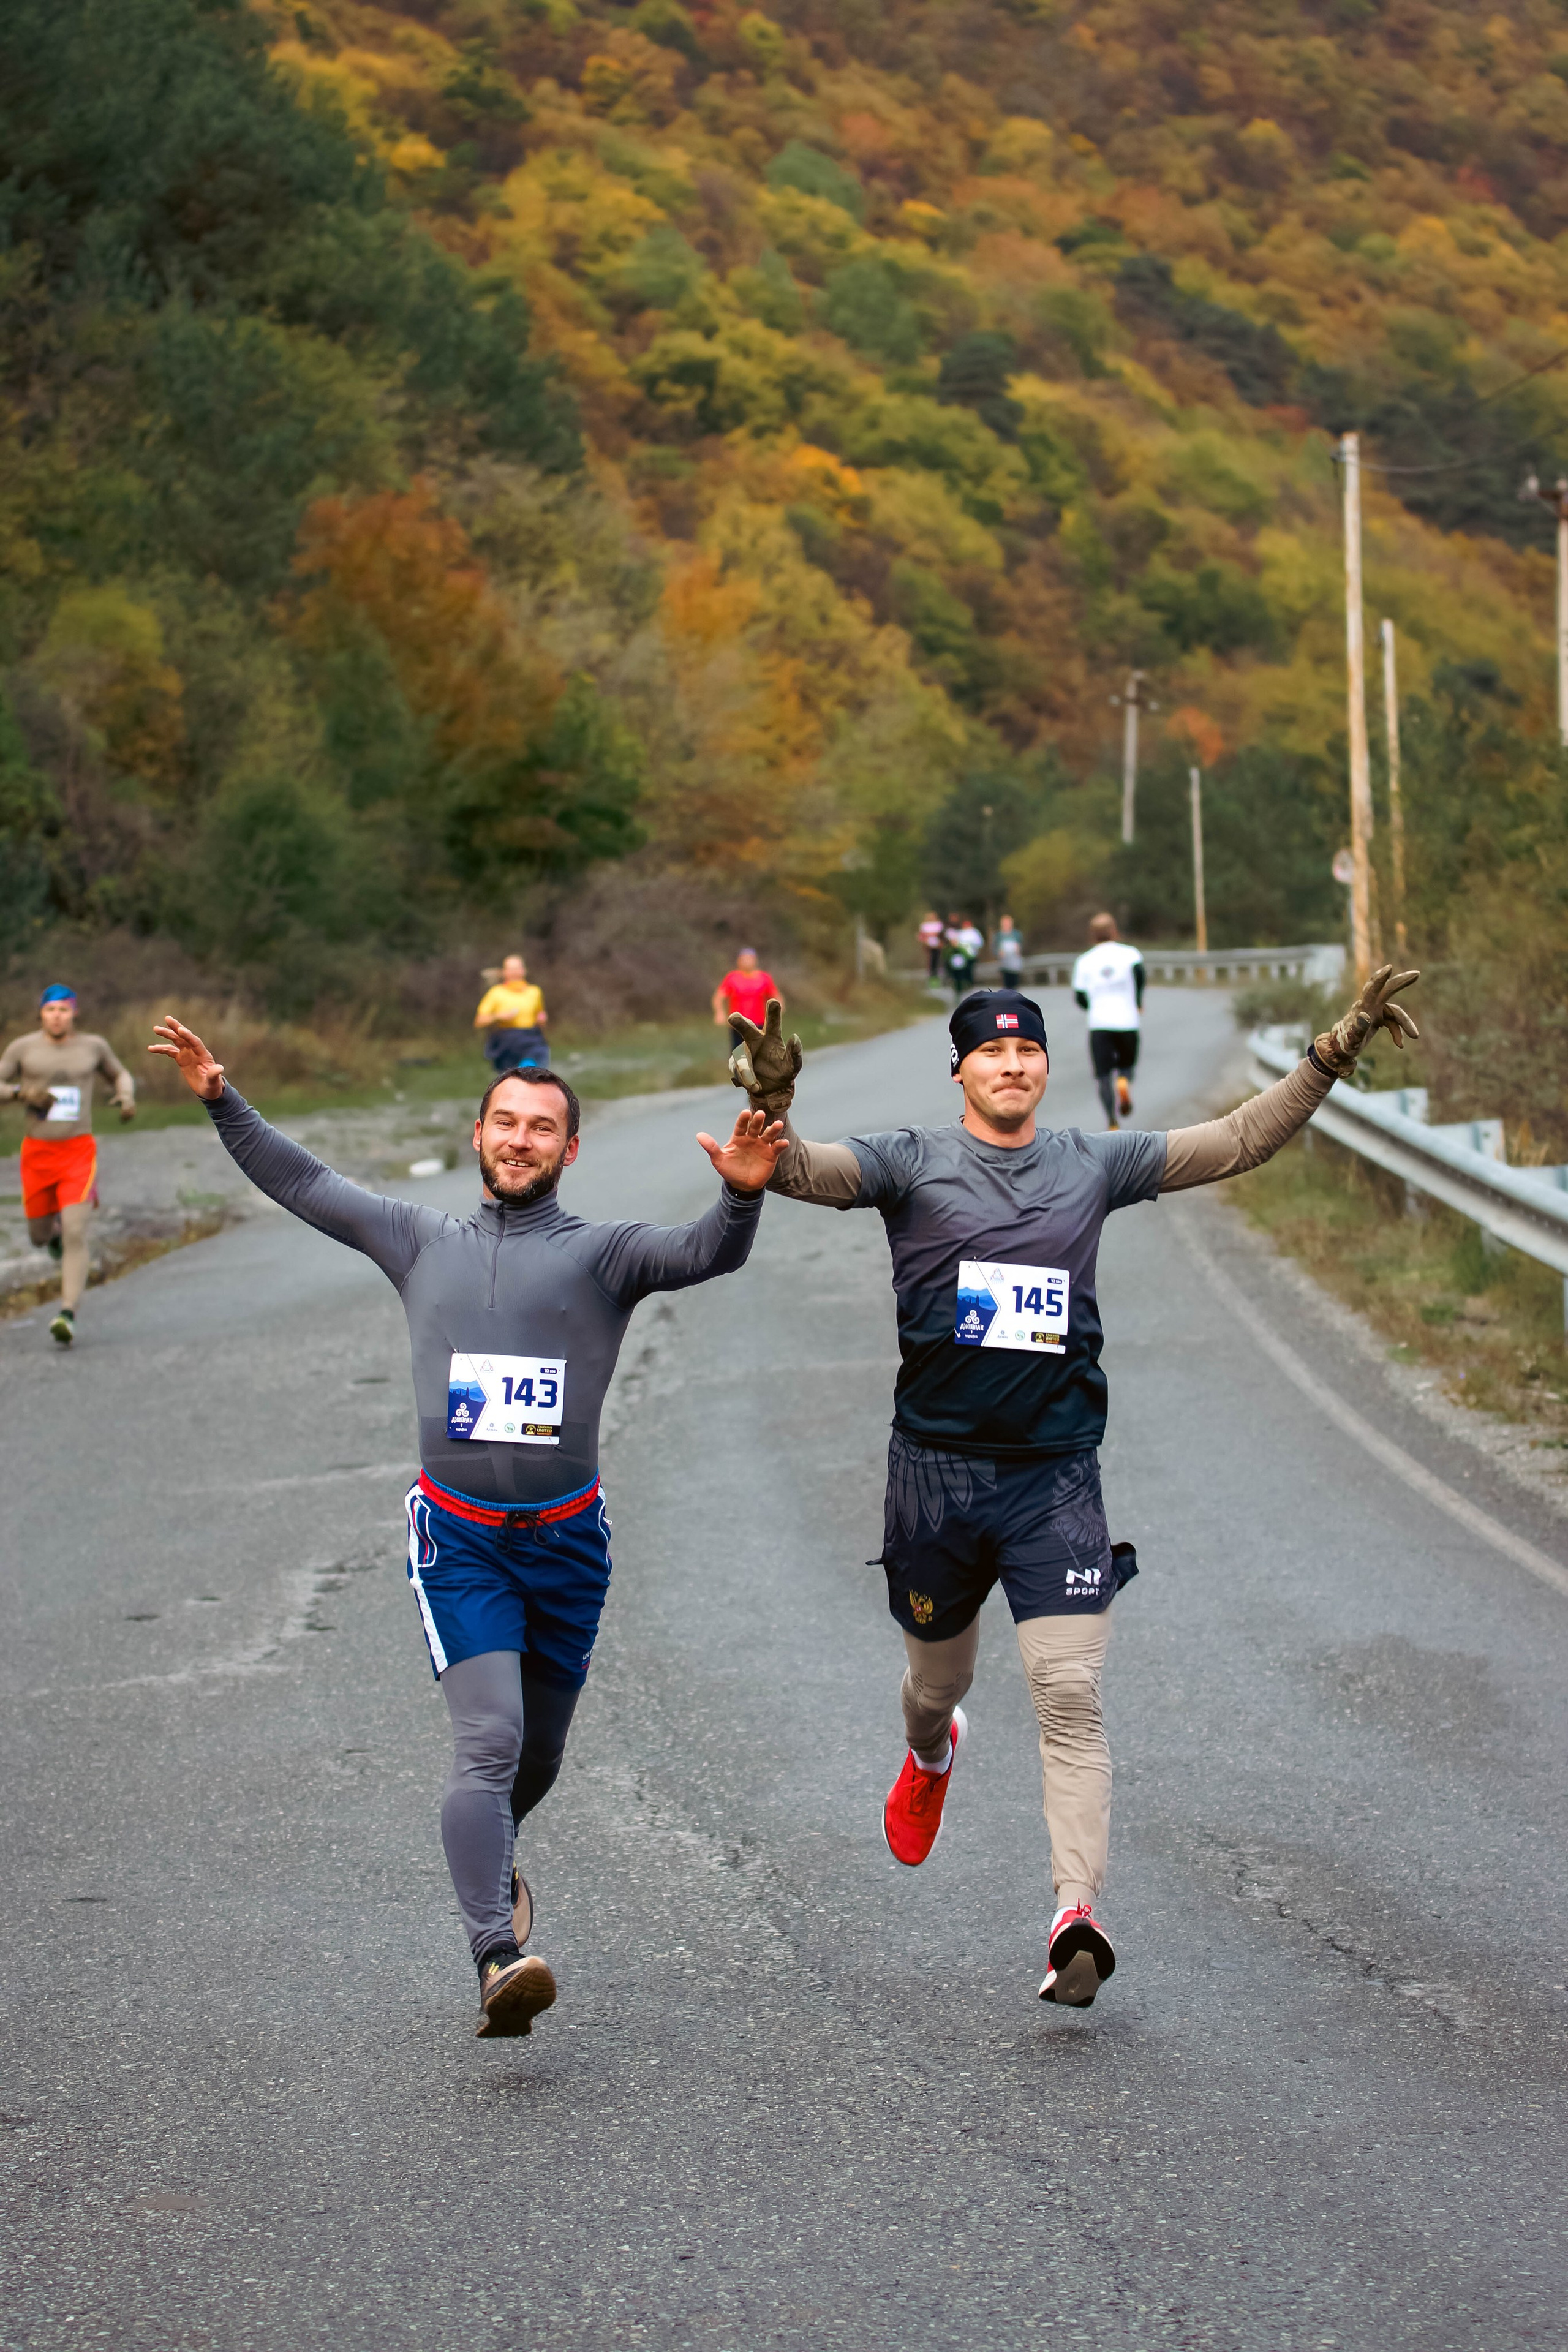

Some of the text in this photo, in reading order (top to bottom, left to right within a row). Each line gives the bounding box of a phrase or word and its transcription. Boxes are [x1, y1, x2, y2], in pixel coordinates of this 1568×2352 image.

[1012, 1286, 1063, 1317] 145
[502, 1376, 558, 1408] 143
[1066, 1587, 1100, 1596] SPORT
